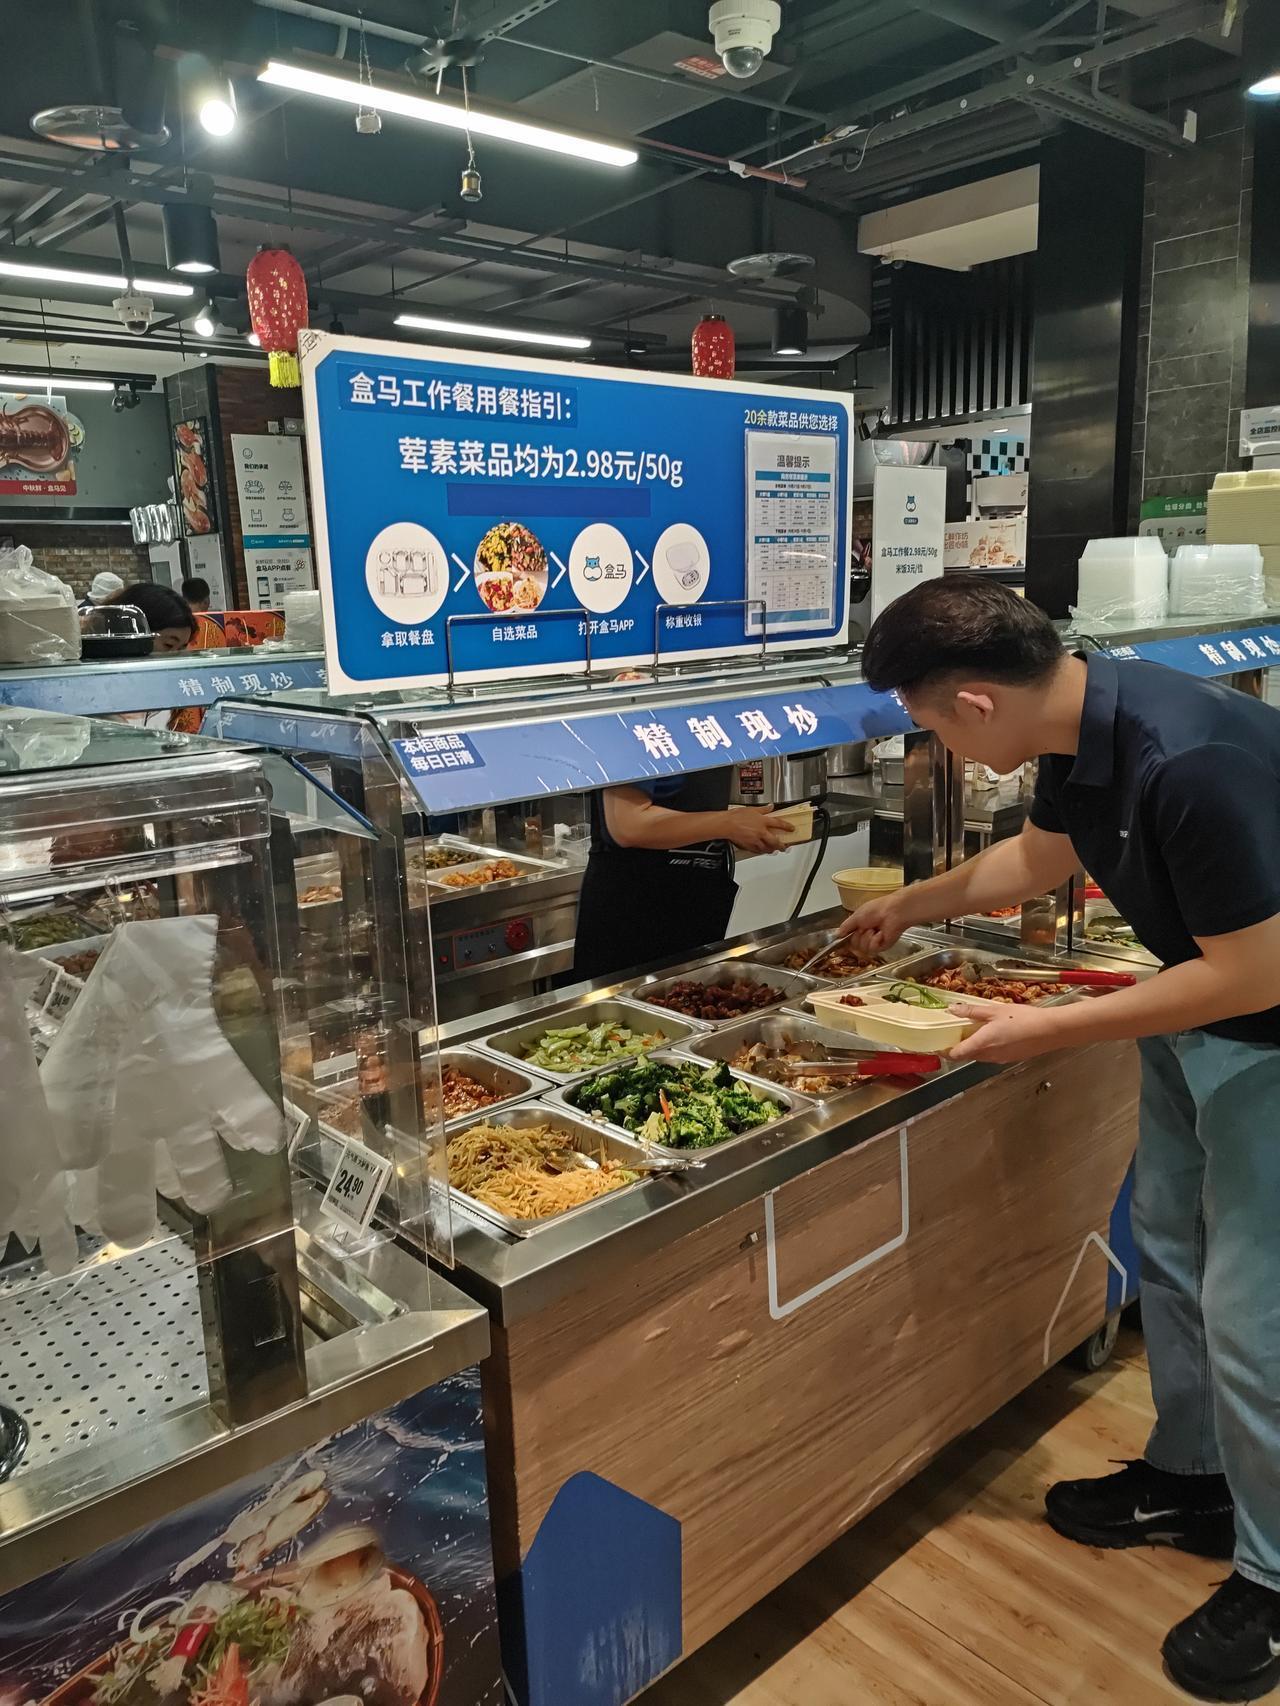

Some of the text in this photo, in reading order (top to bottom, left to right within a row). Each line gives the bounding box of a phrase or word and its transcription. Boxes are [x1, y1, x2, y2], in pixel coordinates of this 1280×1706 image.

[744, 409, 838, 431] 20余款菜品供您选择
[398, 436, 684, 488] 荤素菜品均为2.98元/50g
[777, 455, 810, 469] 温馨提示
[604, 564, 627, 579] 盒马
[578, 619, 634, 636] 打开盒马APP
[665, 613, 702, 629] 称重收银
[381, 629, 435, 648] 拿取餐盘
[492, 625, 538, 642] 自选菜品
[178, 671, 293, 697] 精制现炒
[632, 703, 820, 760] 精制现炒
[401, 735, 466, 754] 本柜商品
